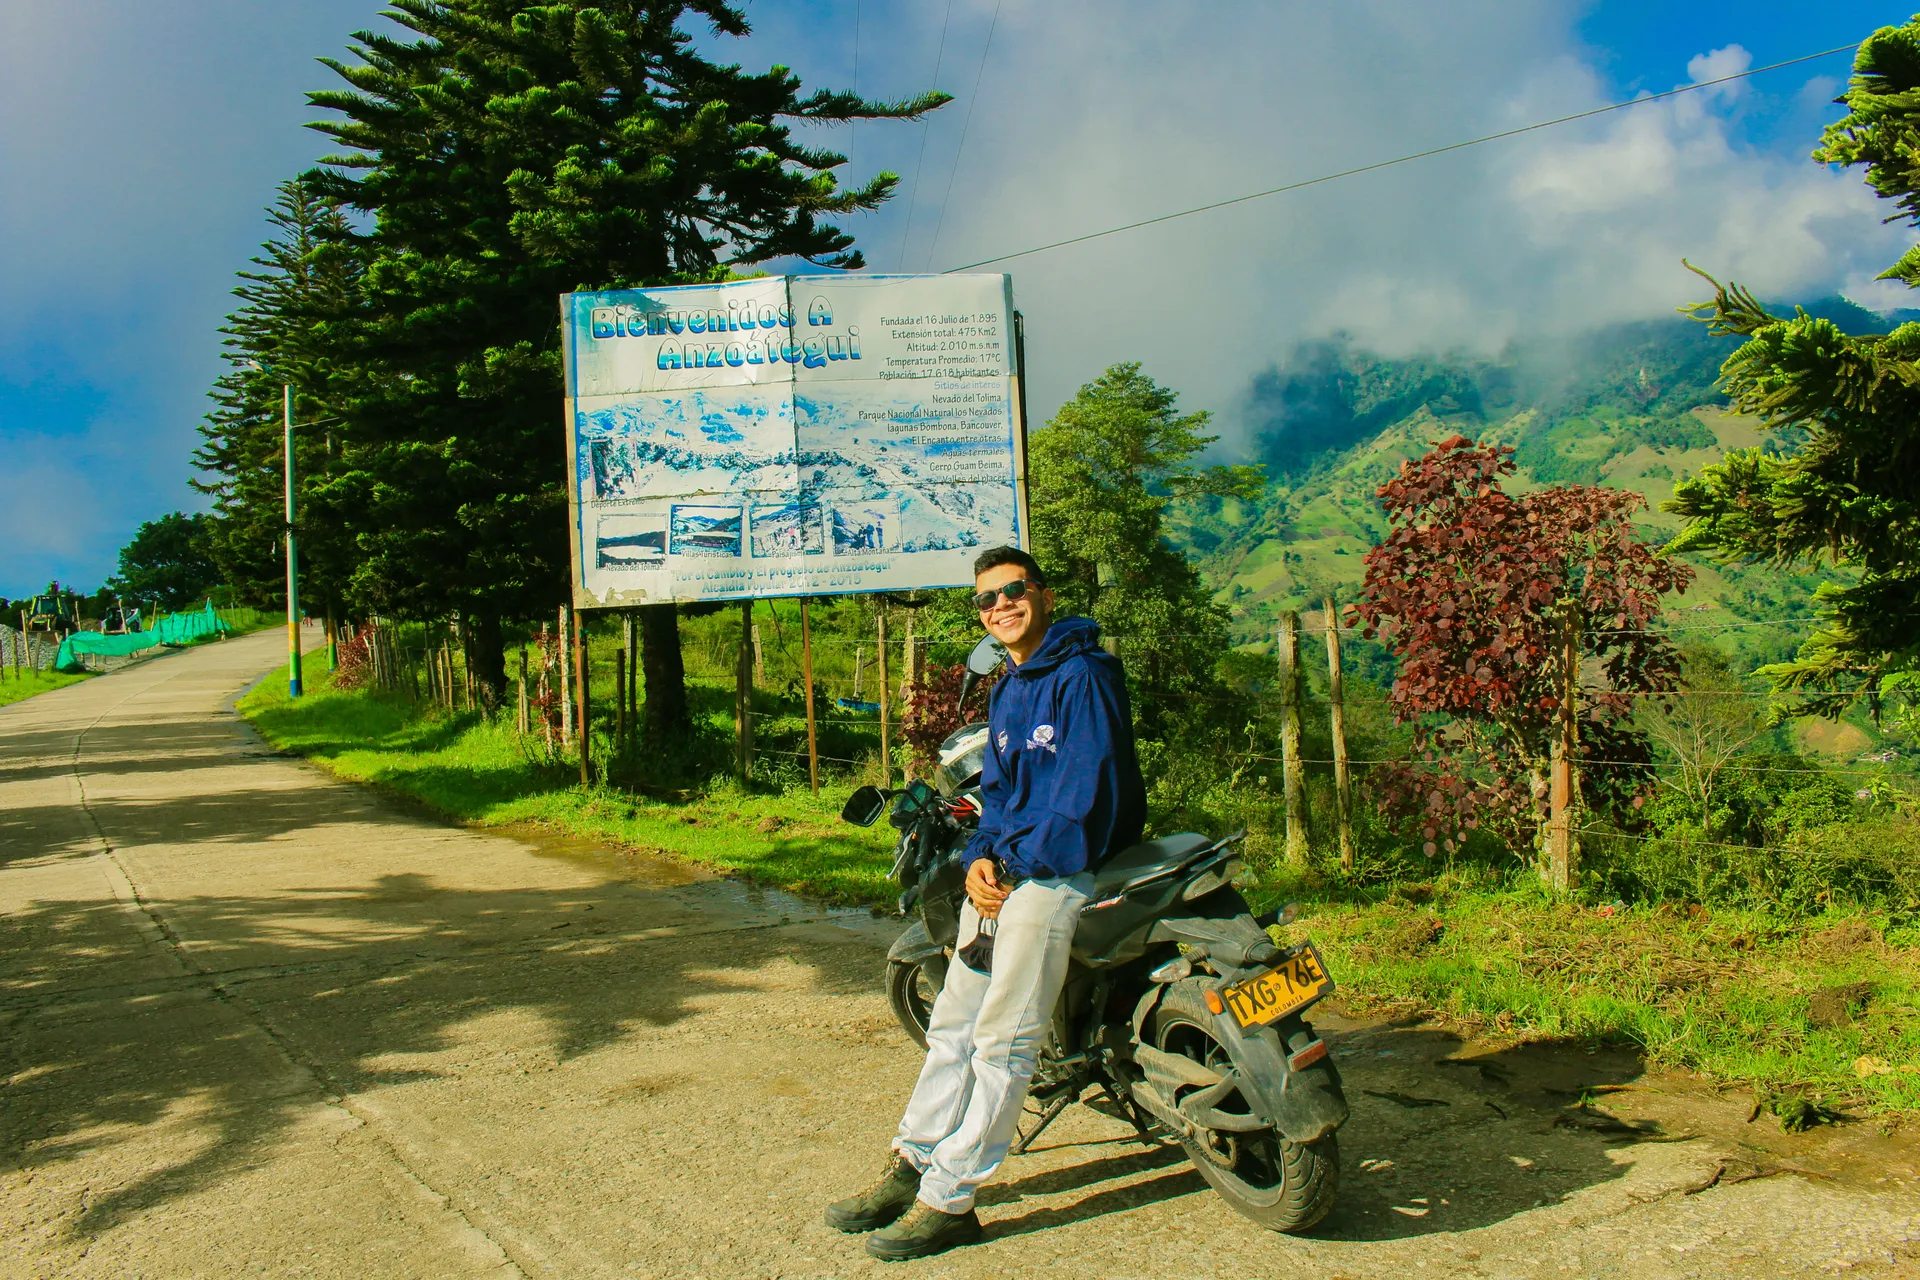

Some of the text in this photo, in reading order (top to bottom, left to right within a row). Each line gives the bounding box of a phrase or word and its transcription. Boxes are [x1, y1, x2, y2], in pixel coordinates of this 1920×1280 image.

[592, 294, 834, 338] Bienvenidos A
[880, 314, 997, 326] Fundada el 16 Julio de 1.895
[892, 326, 997, 339] Extensión total: 475 Km2
[657, 325, 863, 370] Anzoátegui
[906, 342, 938, 352] Altitud:
[940, 341, 968, 351] 2.010
[886, 357, 936, 369] Temperatura
[938, 354, 978, 365] Promedio:
[879, 371, 918, 380] Población:
[934, 381, 960, 390] Sitios
[960, 381, 970, 389] de
[932, 392, 1002, 404] Nevado del Tolima
[858, 407, 1002, 422] Parque Nacional Natural los Nevados
[888, 424, 918, 434] lagunas
[912, 436, 920, 445] El
[922, 436, 954, 444] Encanto
[956, 436, 980, 444] entre
[942, 447, 1004, 458] Aguas termales
[930, 462, 952, 472] Cerro
[954, 461, 976, 470] Guam
[606, 562, 660, 572] Nevado del Tolima
[706, 567, 746, 580] Cambio
[747, 569, 754, 580] y
[830, 574, 862, 586] 2015
[1228, 954, 1324, 1020] TXG 76E
[1270, 995, 1304, 1016] COLOMBIA
